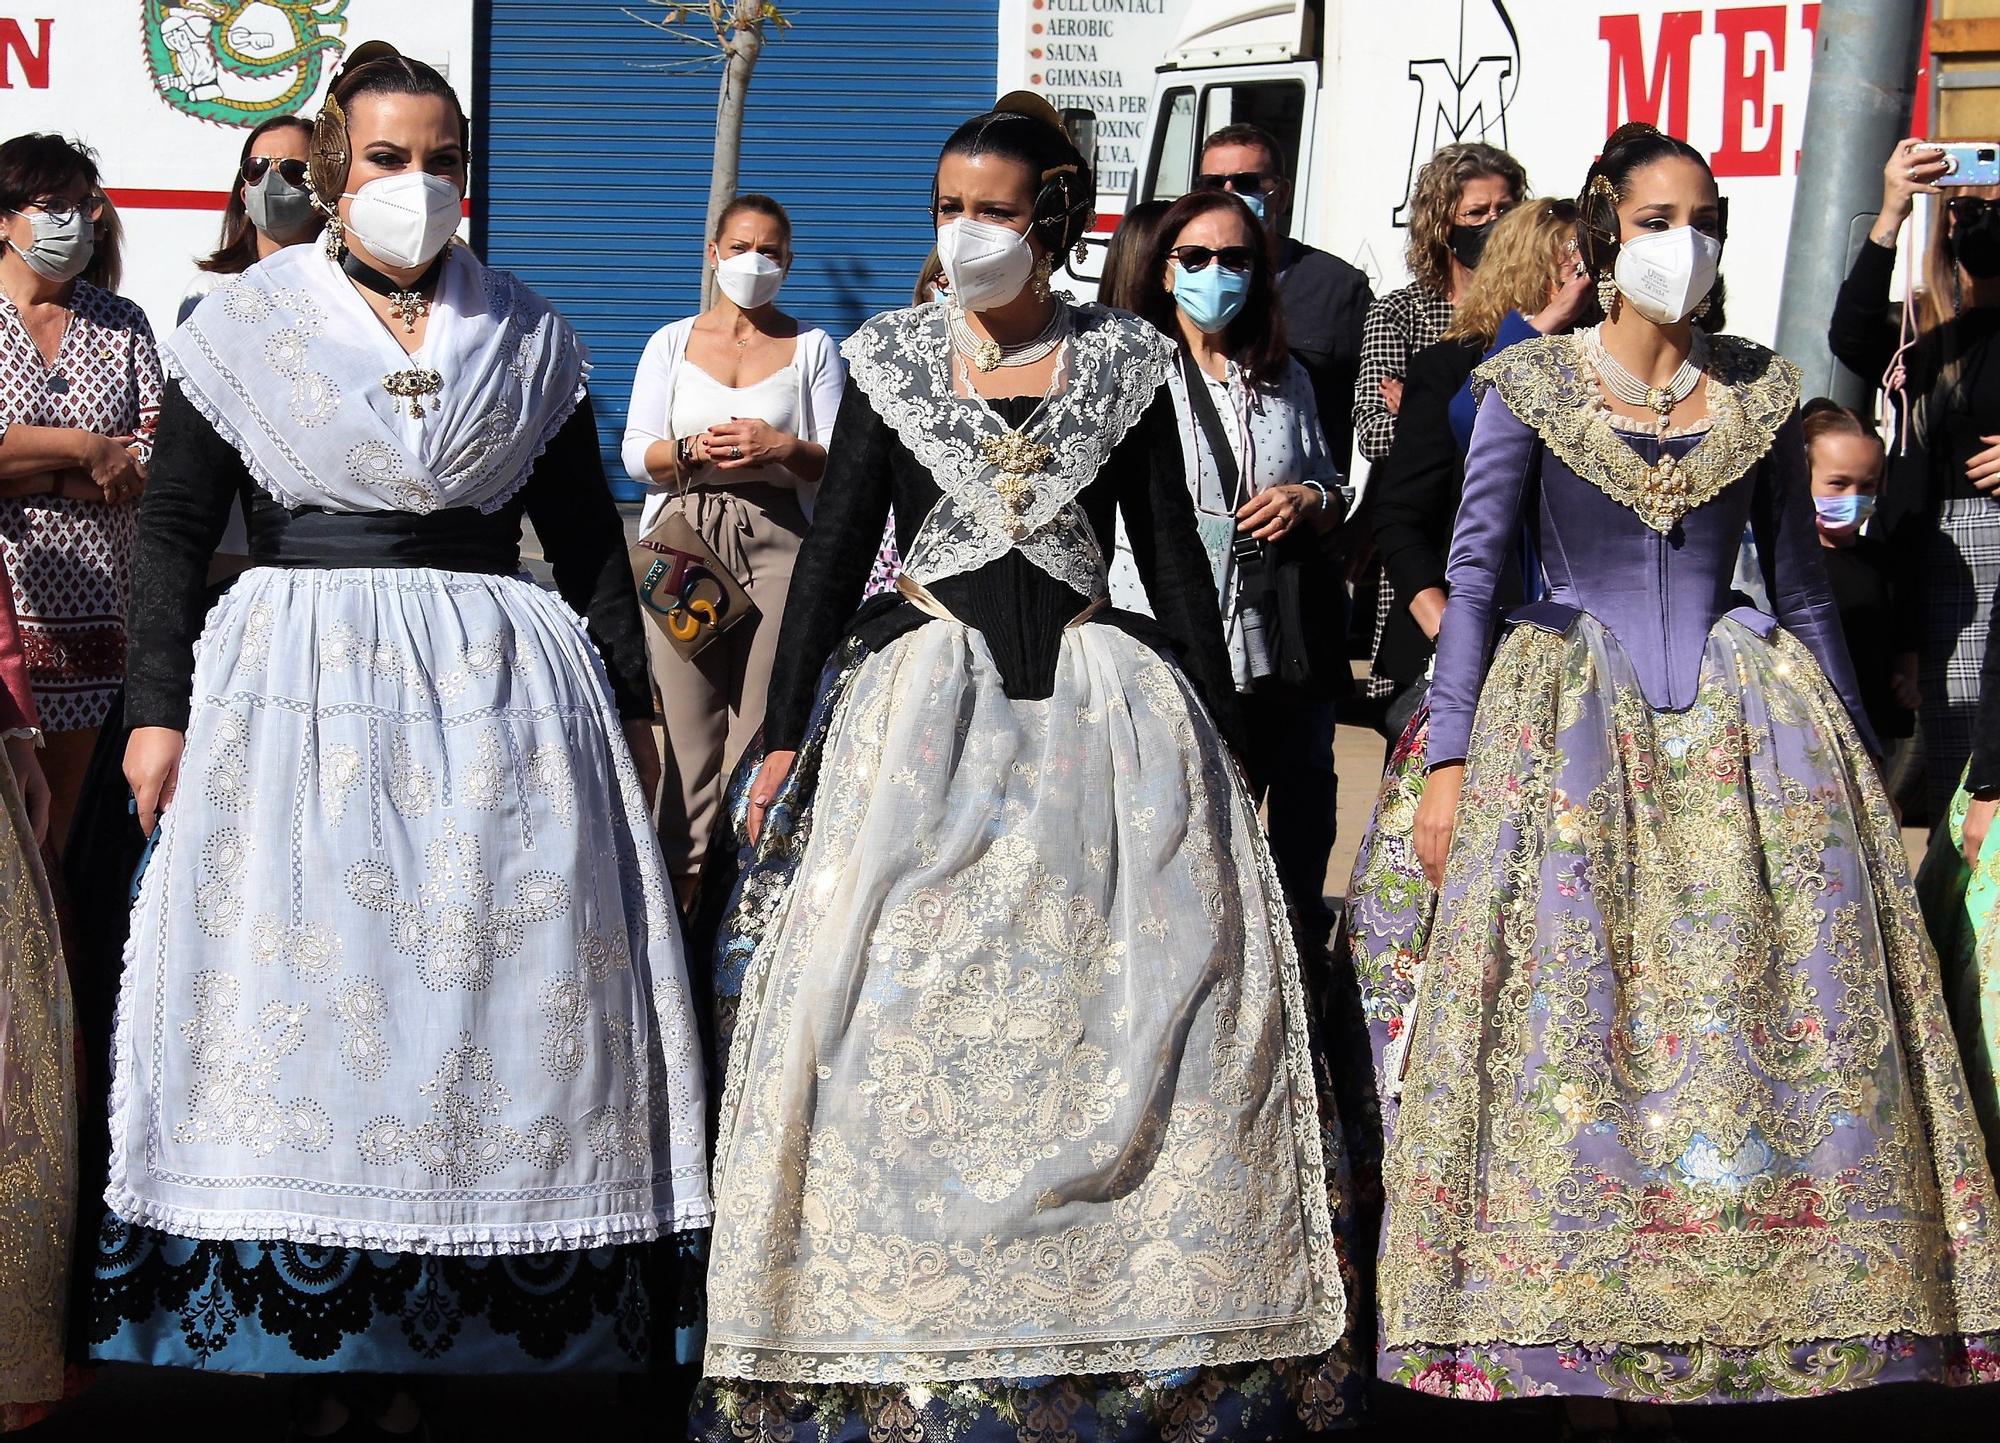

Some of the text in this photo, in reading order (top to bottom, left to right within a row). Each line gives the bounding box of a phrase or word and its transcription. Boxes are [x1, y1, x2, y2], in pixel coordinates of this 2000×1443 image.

[1093, 0, 1165, 14] CONTACT
[1046, 19, 1114, 38] AEROBIC
[1046, 44, 1098, 62] SAUNA
[1045, 69, 1123, 88] GIMNASIA
